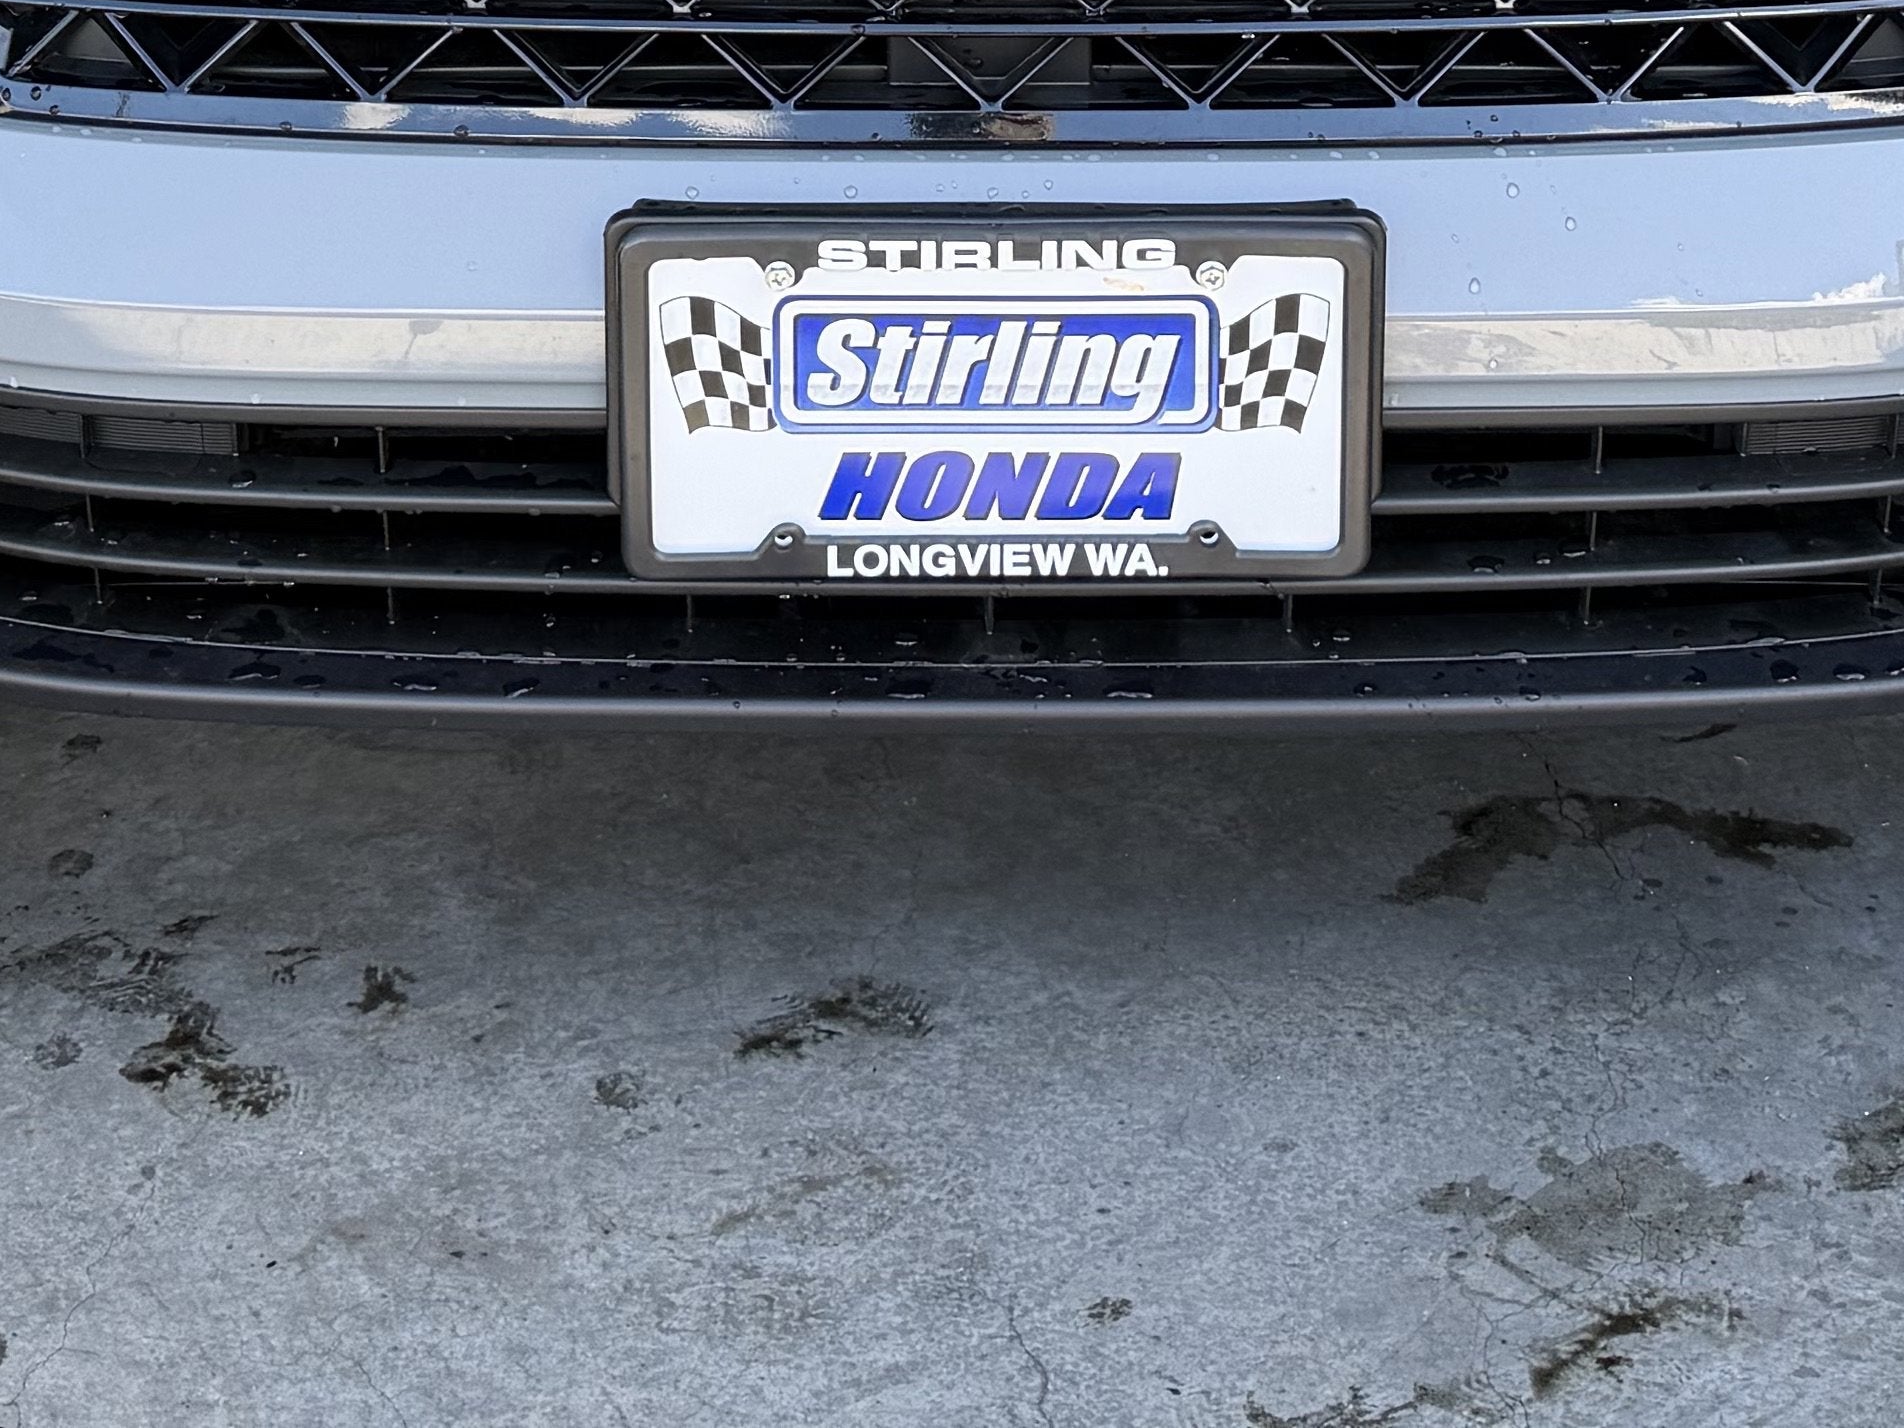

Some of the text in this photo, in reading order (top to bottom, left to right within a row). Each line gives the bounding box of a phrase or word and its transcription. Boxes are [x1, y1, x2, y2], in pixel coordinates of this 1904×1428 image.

[816, 239, 1177, 271] STIRLING
[808, 318, 1182, 425] Stirling
[817, 451, 1182, 521] HONDA
[827, 543, 1169, 577] LONGVIEW WA.
